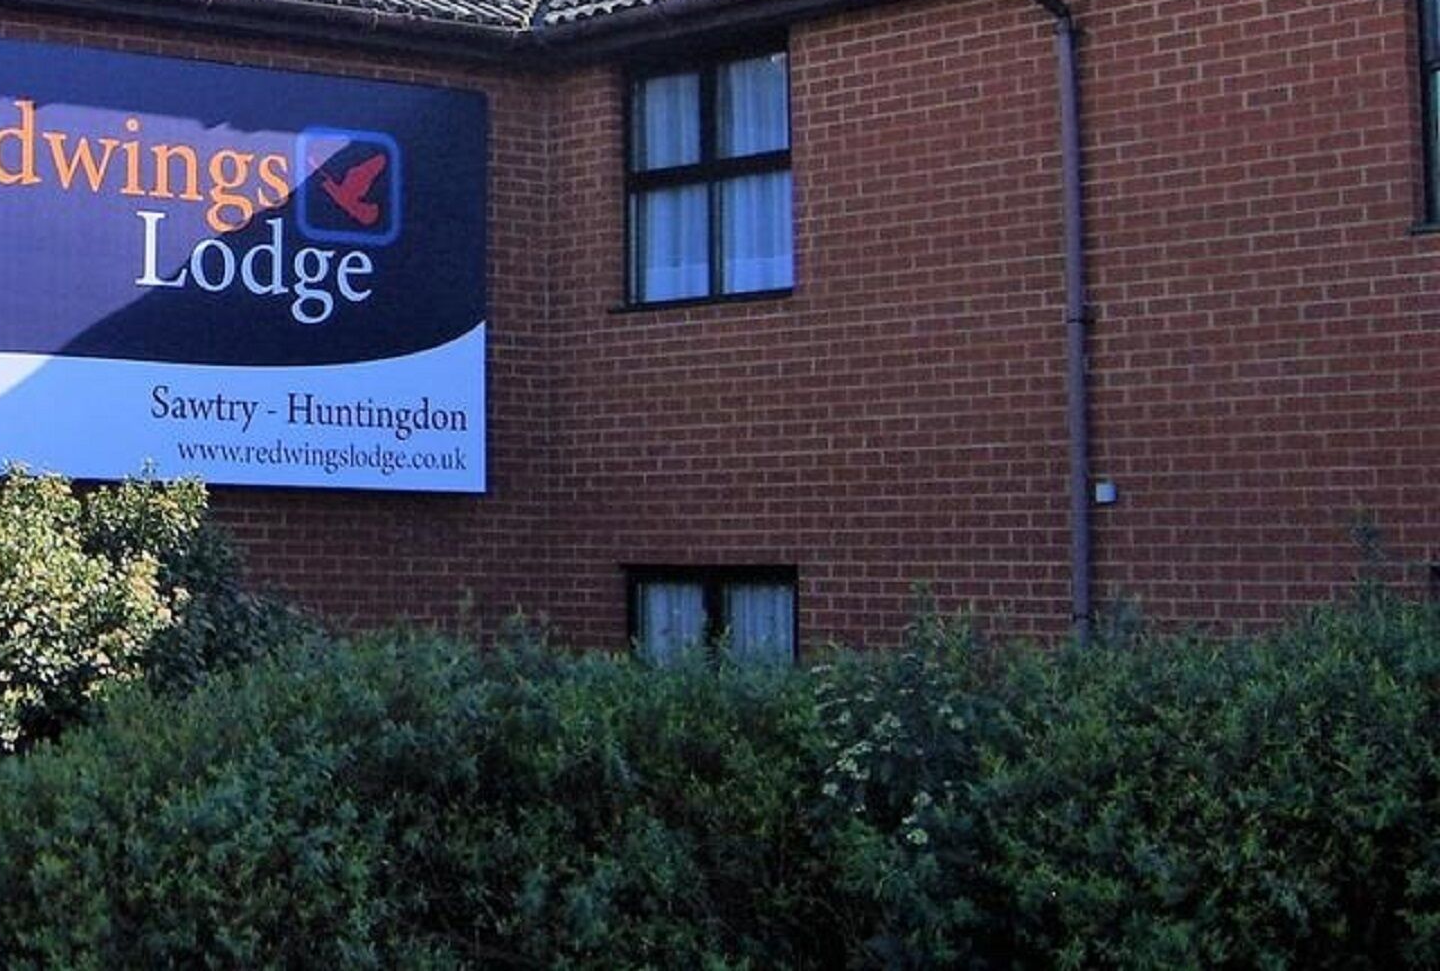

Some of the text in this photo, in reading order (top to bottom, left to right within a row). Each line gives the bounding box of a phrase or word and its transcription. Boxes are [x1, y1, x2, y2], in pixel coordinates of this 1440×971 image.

[136, 211, 373, 324] Lodge
[151, 385, 258, 432] Sawtry
[287, 392, 467, 439] Huntingdon
[177, 438, 467, 475] www.redwingslodge.co.uk
